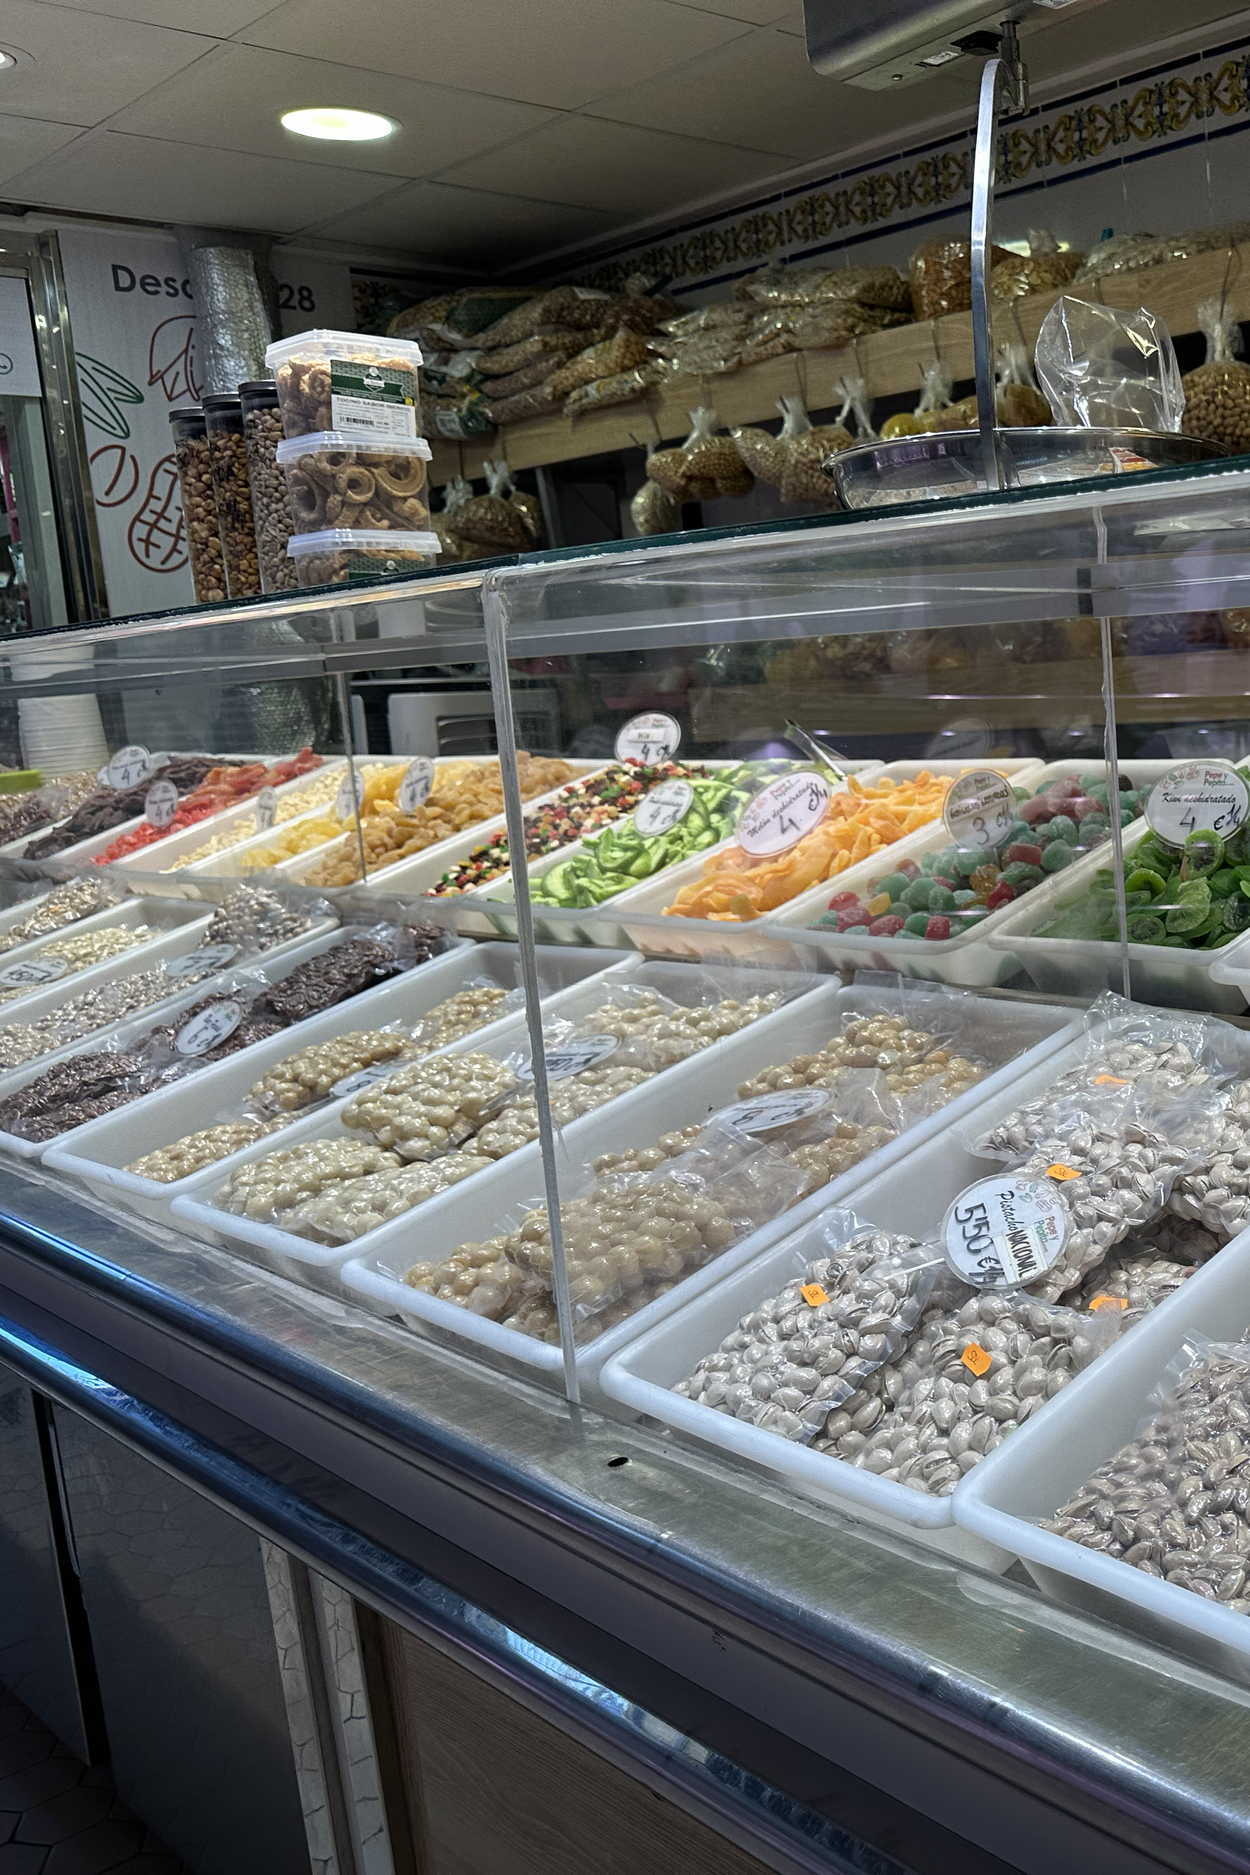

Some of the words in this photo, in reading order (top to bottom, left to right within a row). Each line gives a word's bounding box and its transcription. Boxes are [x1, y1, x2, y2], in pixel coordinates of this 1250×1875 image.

[1204, 770, 1222, 779] Pepe
[772, 781, 814, 819] deshidratado
[1184, 792, 1236, 804] deshidratado
[779, 814, 801, 835] 4
[972, 816, 990, 845] 3
[1179, 807, 1196, 834] 4
[995, 1190, 1025, 1234] Pistacho
